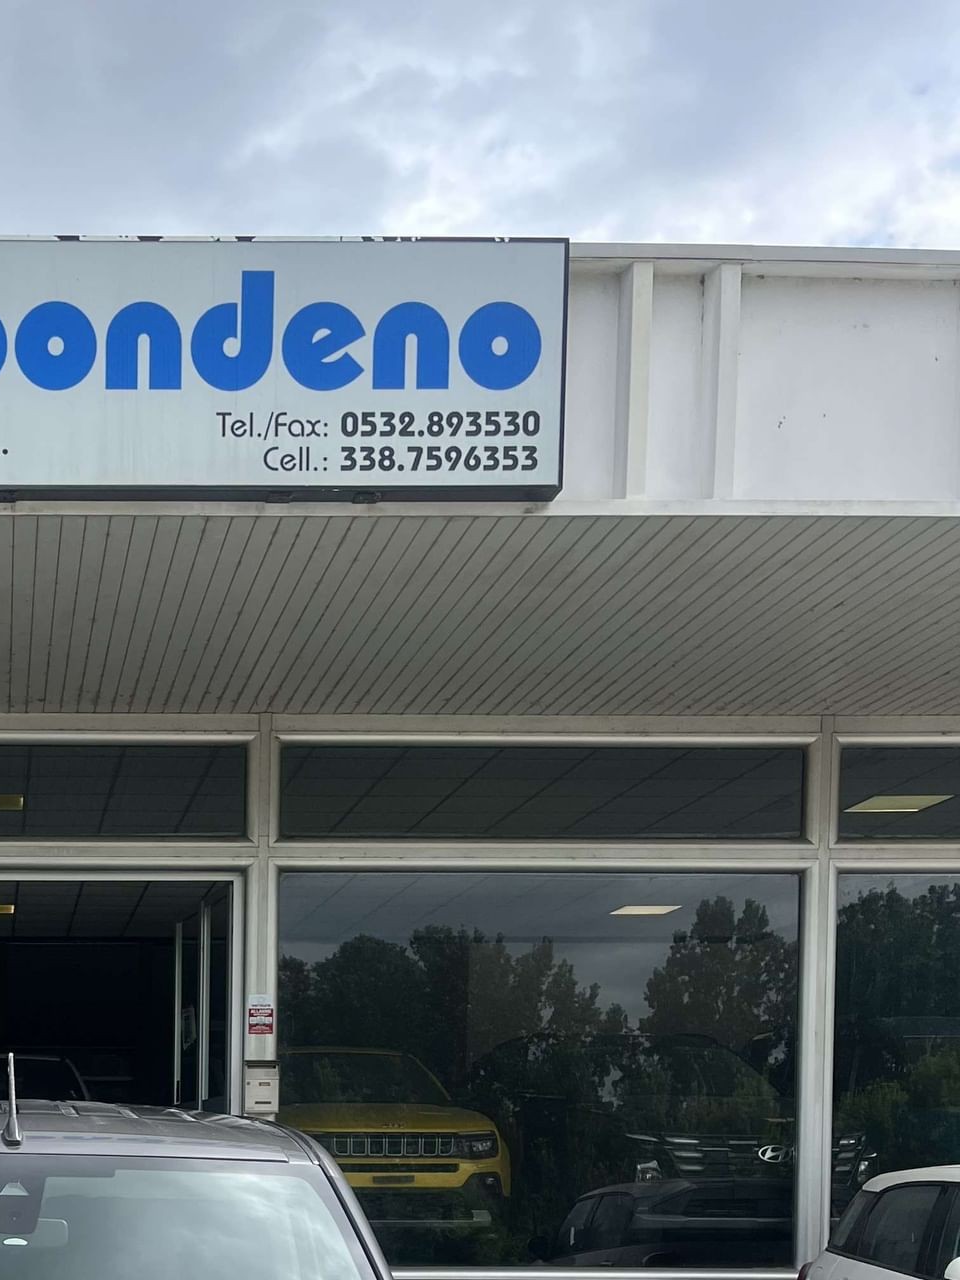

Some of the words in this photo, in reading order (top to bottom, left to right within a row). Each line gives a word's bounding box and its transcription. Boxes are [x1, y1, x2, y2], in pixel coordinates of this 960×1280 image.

[215, 411, 329, 441] Tel./Fax:
[340, 410, 541, 438] 0532.893530
[263, 446, 328, 472] Cell.:
[340, 445, 539, 472] 338.7596353
